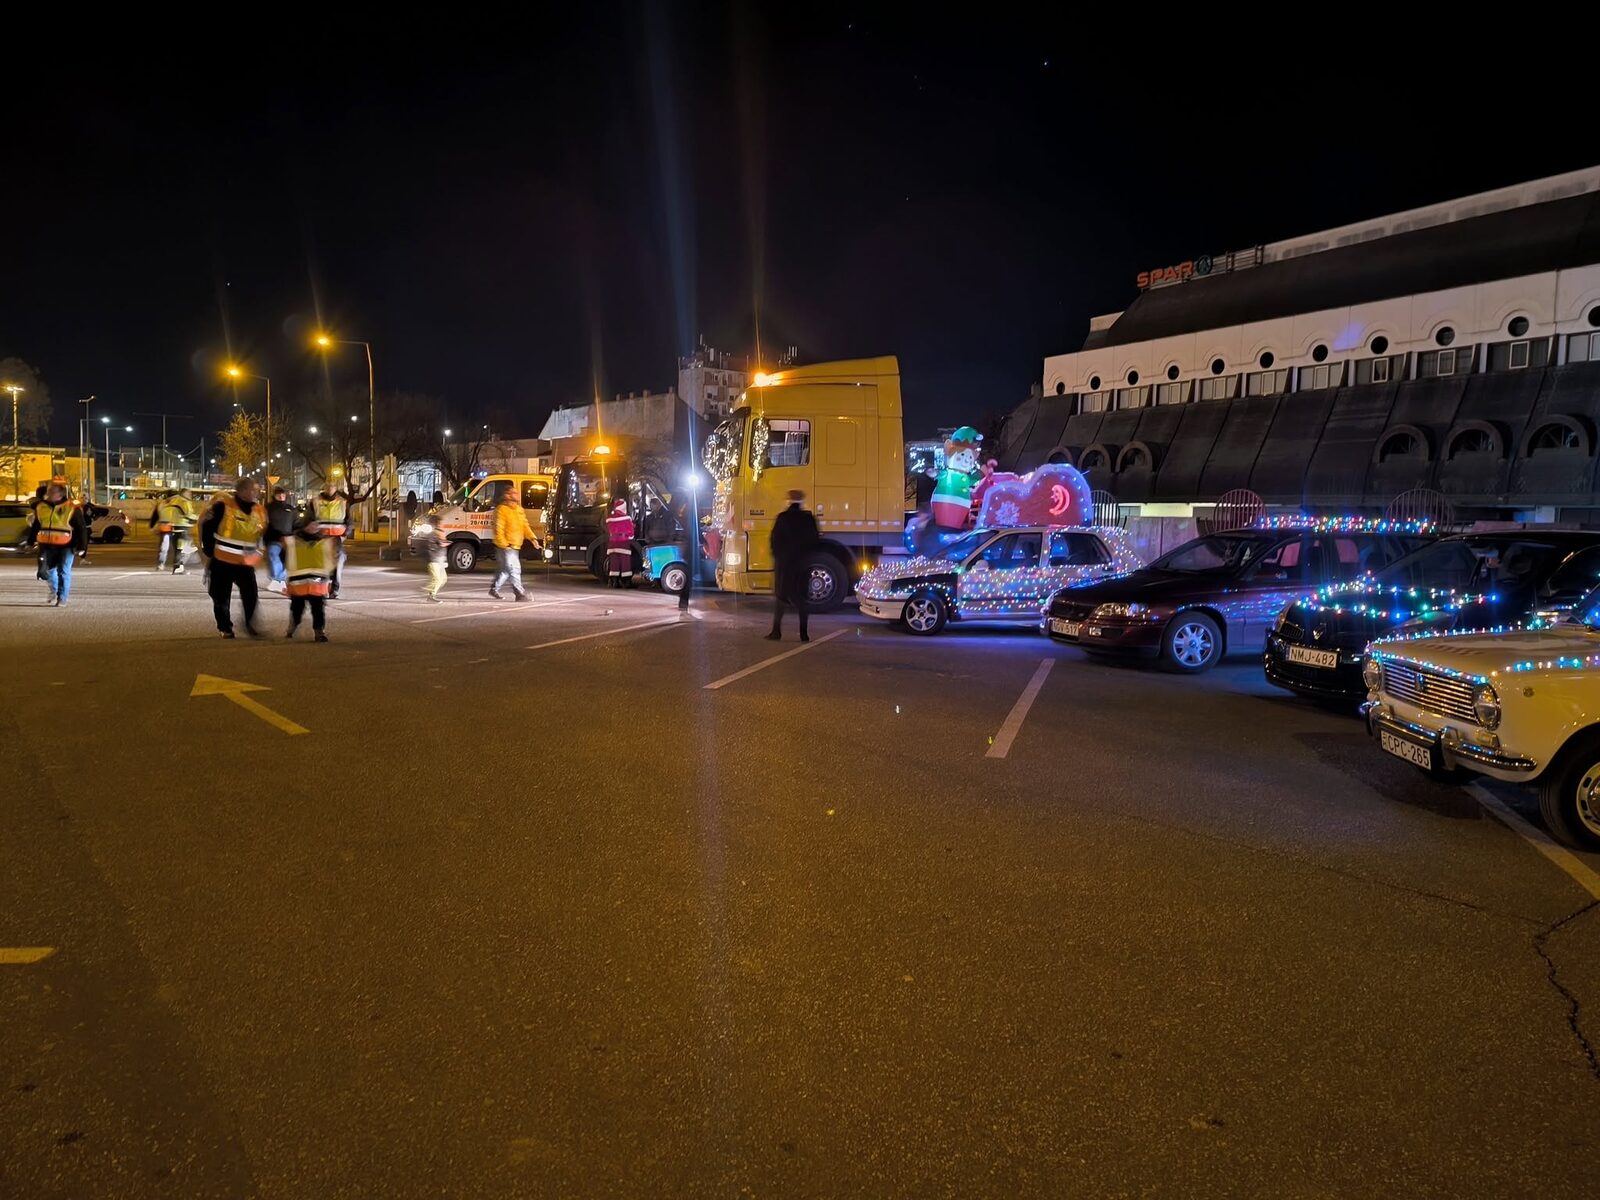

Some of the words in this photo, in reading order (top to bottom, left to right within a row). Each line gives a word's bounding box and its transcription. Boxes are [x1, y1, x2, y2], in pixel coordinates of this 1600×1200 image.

[1137, 260, 1194, 288] SPAR
[1291, 648, 1335, 667] NMJ-482
[1387, 735, 1430, 767] CPC-265
